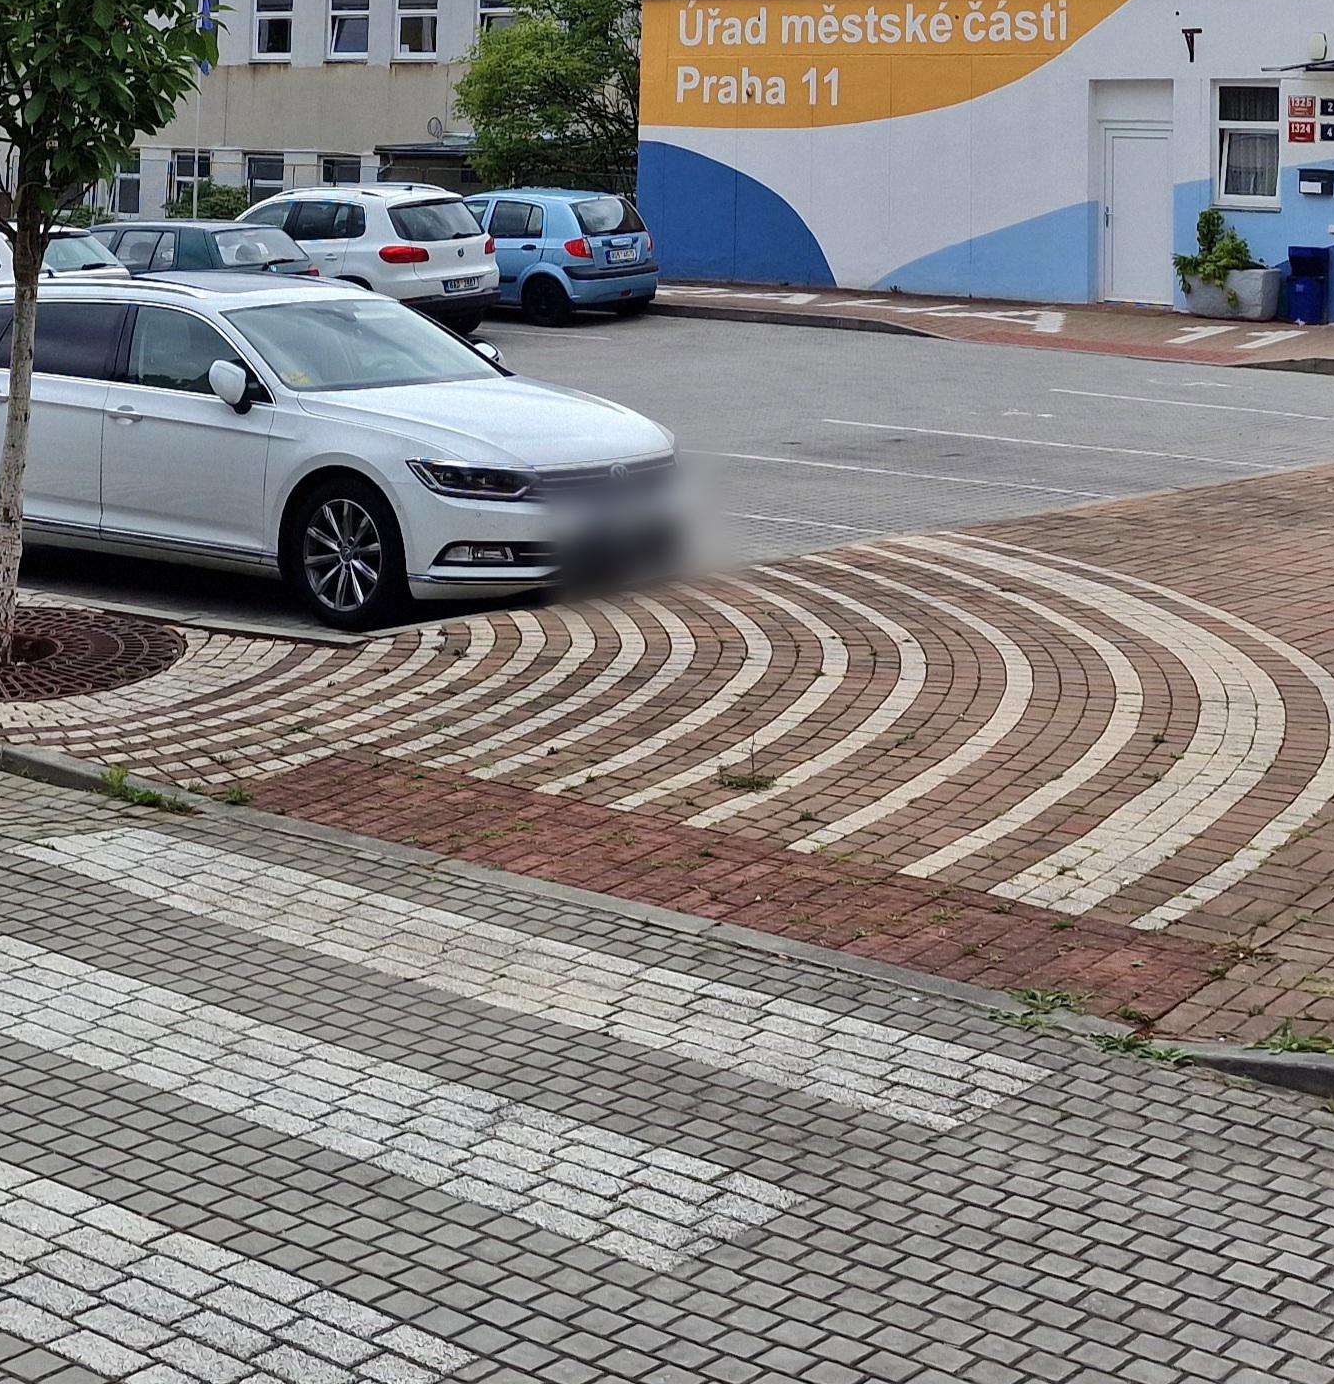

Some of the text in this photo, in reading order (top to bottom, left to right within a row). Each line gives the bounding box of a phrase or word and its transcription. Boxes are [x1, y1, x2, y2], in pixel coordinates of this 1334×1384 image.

[678, 0, 1068, 47] Úřad městské části
[675, 65, 840, 106] Praha 11
[1291, 97, 1312, 107] 1325
[1327, 102, 1334, 112] 2
[1290, 123, 1311, 133] 1324
[1326, 127, 1333, 137] 4
